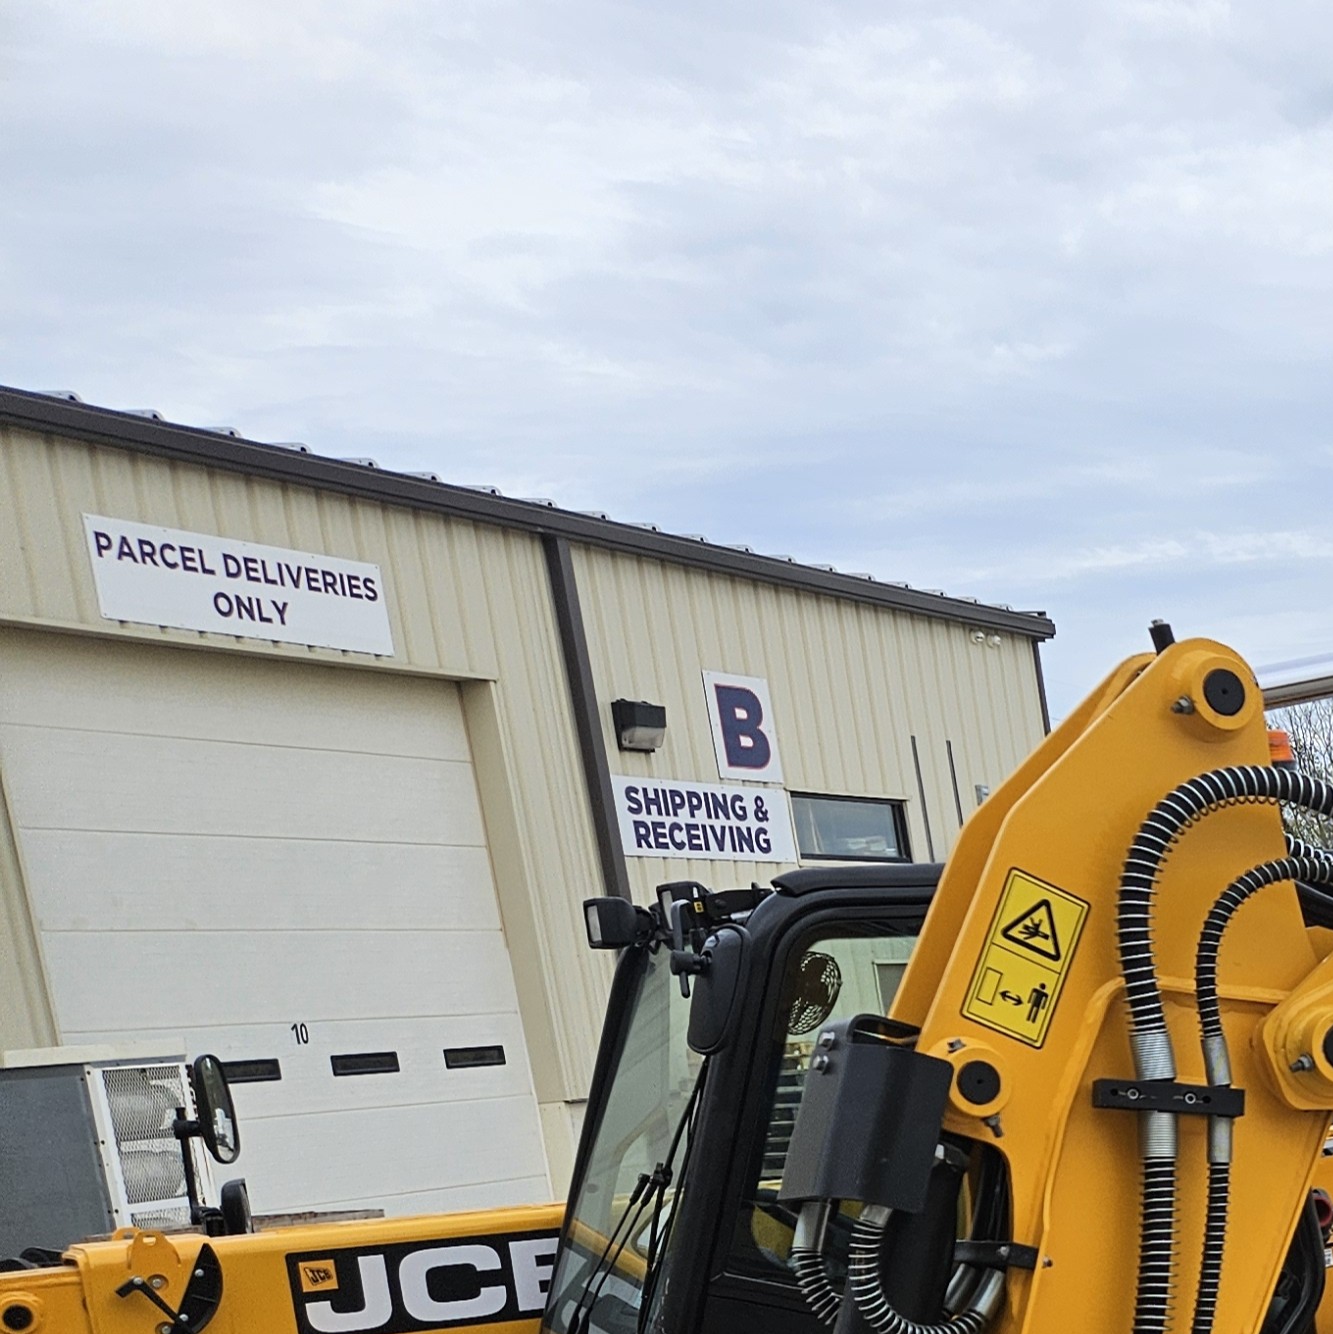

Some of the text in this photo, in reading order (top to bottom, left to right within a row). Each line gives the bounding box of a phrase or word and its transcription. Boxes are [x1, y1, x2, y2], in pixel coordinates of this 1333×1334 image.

[93, 530, 379, 602] PARCEL DELIVERIES
[213, 591, 289, 626] ONLY
[713, 683, 771, 770] B
[624, 785, 770, 823] SHIPPING &
[632, 819, 772, 854] RECEIVING
[291, 1022, 309, 1045] 10
